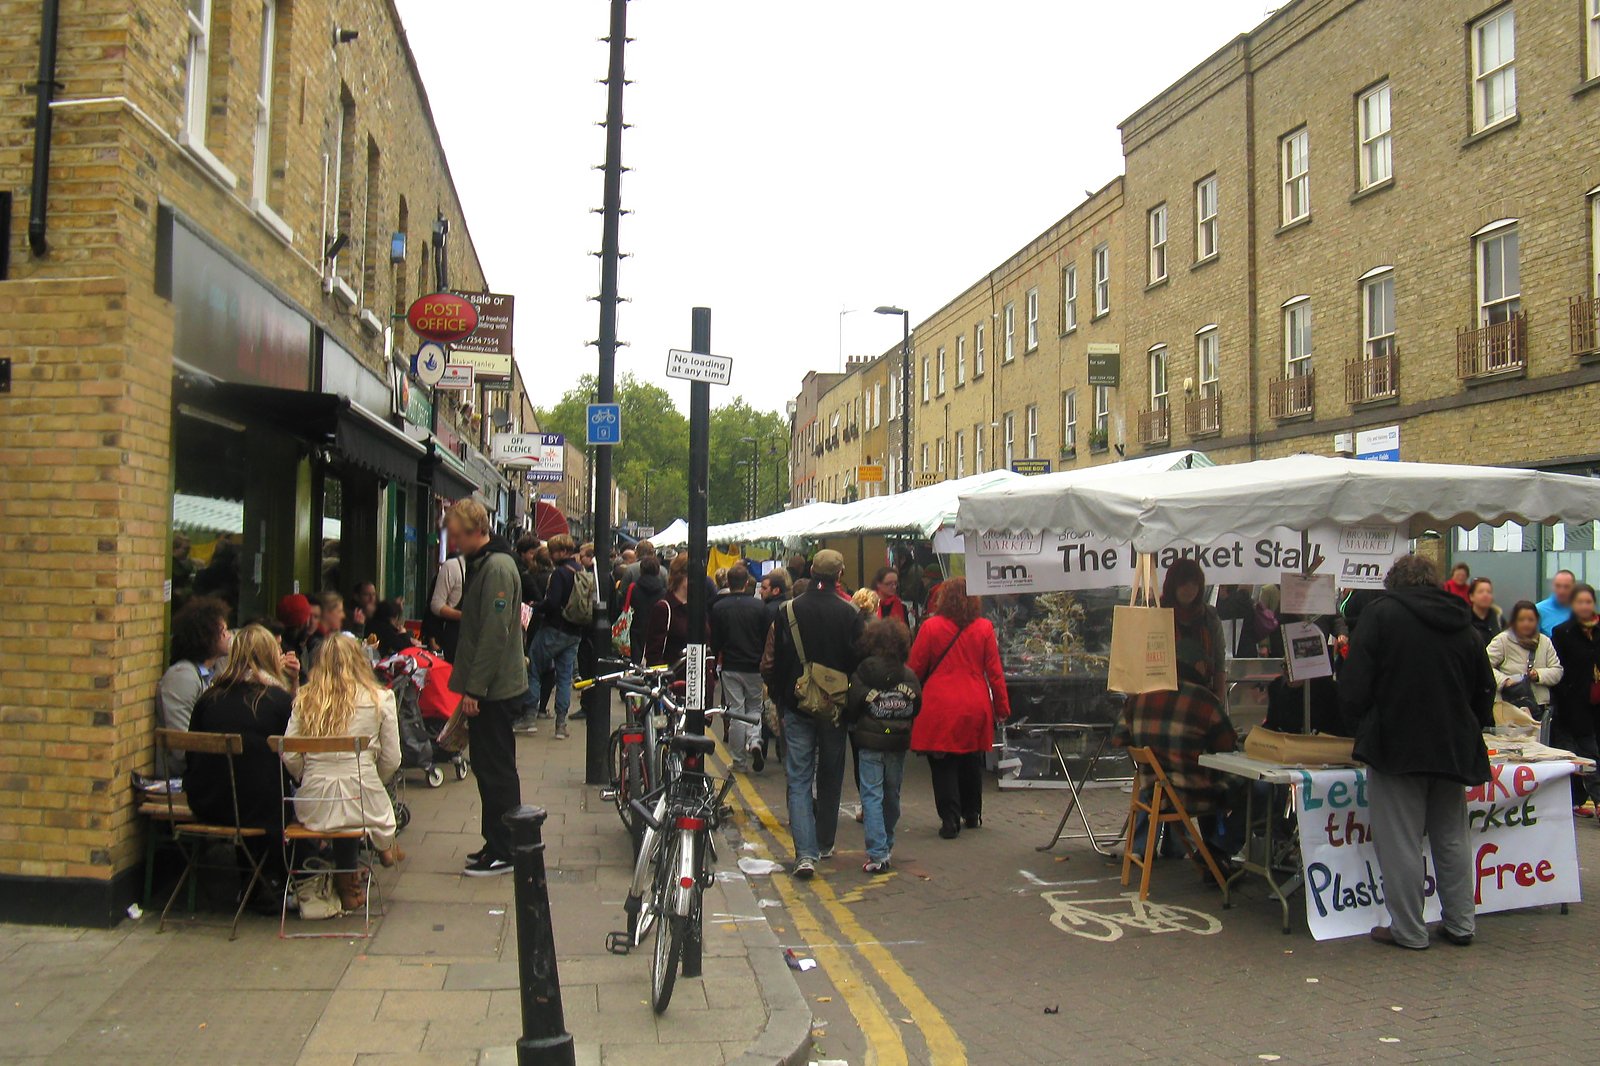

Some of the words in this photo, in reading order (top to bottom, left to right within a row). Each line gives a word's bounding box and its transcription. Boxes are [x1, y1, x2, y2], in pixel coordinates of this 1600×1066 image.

[470, 294, 491, 305] sale
[493, 297, 504, 306] or
[424, 303, 463, 316] POST
[416, 317, 467, 332] OFFICE
[454, 343, 499, 353] lakestanley.co.uk
[673, 354, 688, 364] No
[690, 356, 726, 371] loading
[671, 364, 682, 373] at
[684, 367, 701, 378] any
[704, 367, 725, 380] time
[548, 434, 559, 444] BY
[600, 428, 607, 437] 9
[511, 437, 524, 445] OFF
[503, 445, 532, 453] LICENCE
[983, 540, 1034, 551] MARKET
[1345, 540, 1389, 550] MARKET
[1057, 543, 1118, 573] The
[1301, 770, 1369, 811] Let
[1469, 796, 1538, 833] rket
[1325, 811, 1373, 847] th
[1473, 842, 1556, 905] free
